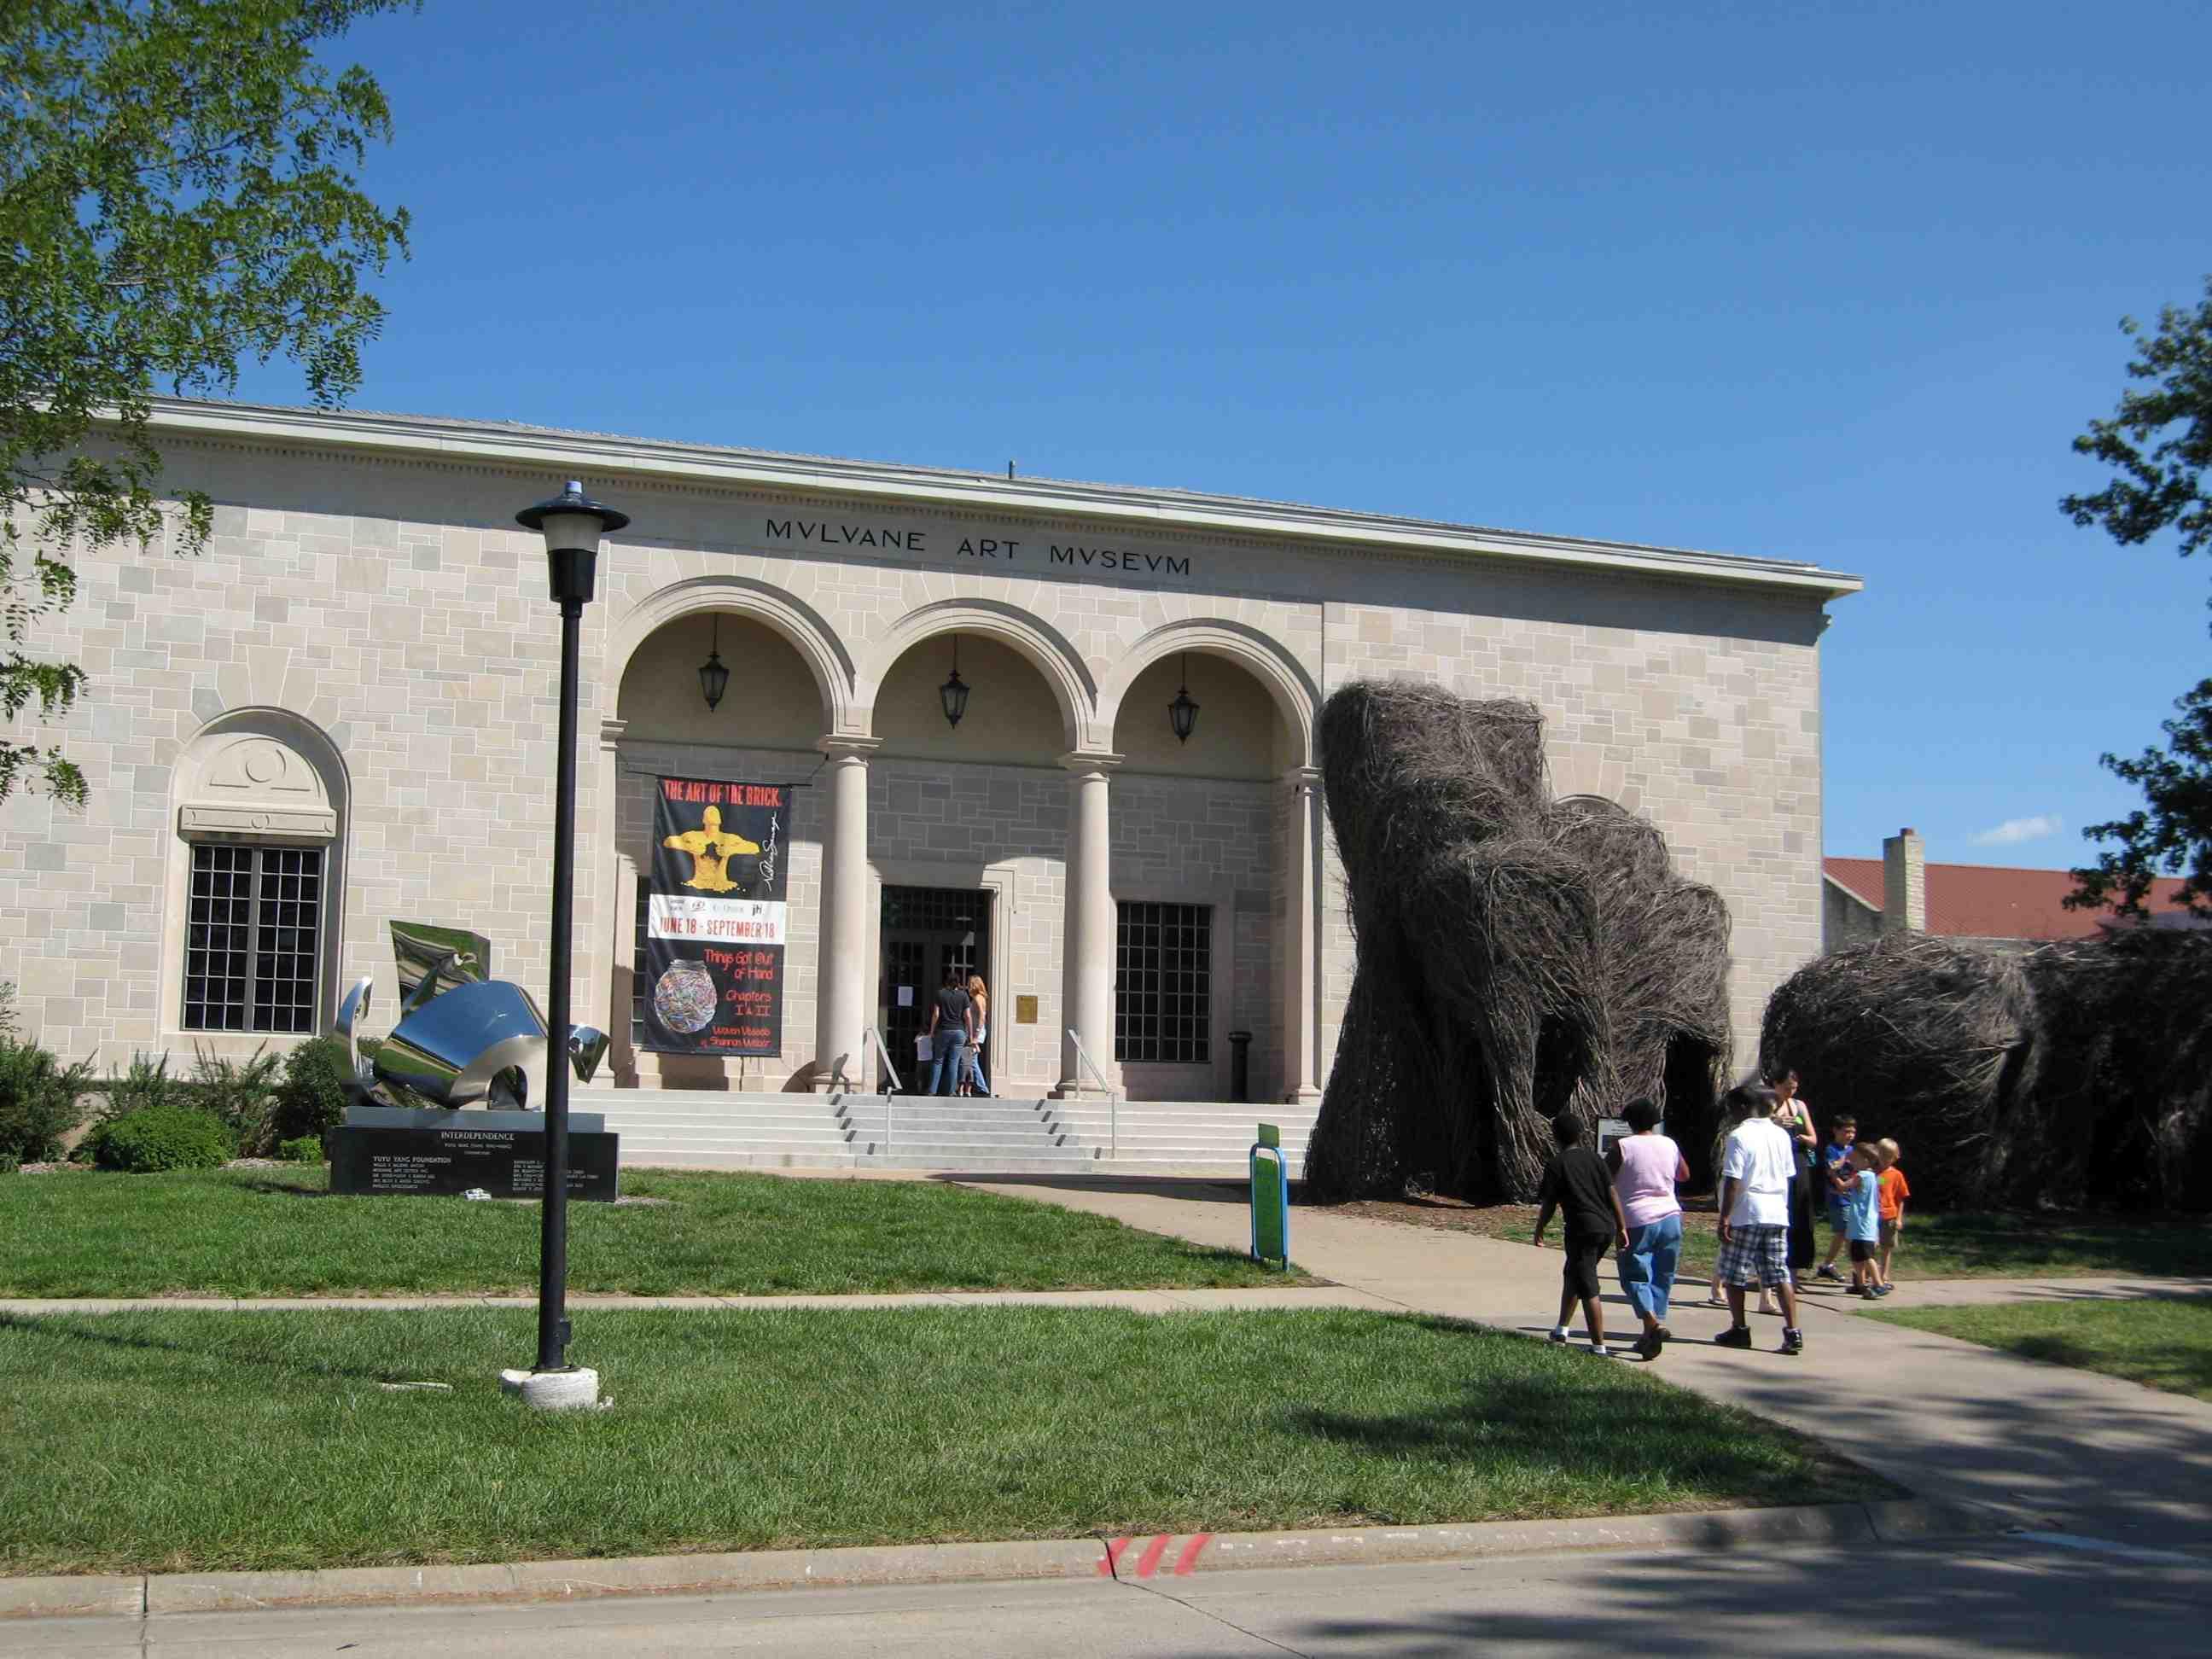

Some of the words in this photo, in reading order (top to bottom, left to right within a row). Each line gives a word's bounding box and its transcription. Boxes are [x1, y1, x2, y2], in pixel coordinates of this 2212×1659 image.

[766, 518, 926, 551] MVLVANE
[957, 538, 1020, 559] ART
[1051, 545, 1189, 575] MVSEVM
[664, 779, 684, 800] THE
[686, 783, 707, 802] ART
[710, 784, 723, 804] OF
[725, 785, 743, 806] THE
[661, 917, 683, 934] JUNE
[686, 918, 697, 934] 18
[707, 919, 762, 938] SEPTEMBER
[765, 923, 776, 938] 18
[704, 949, 734, 970] Things
[736, 952, 752, 965] Got
[755, 952, 774, 965] Out
[748, 967, 773, 981] Hand
[725, 990, 772, 1007] Chapters
[440, 1131, 515, 1141] INTERDEPENDENCE
